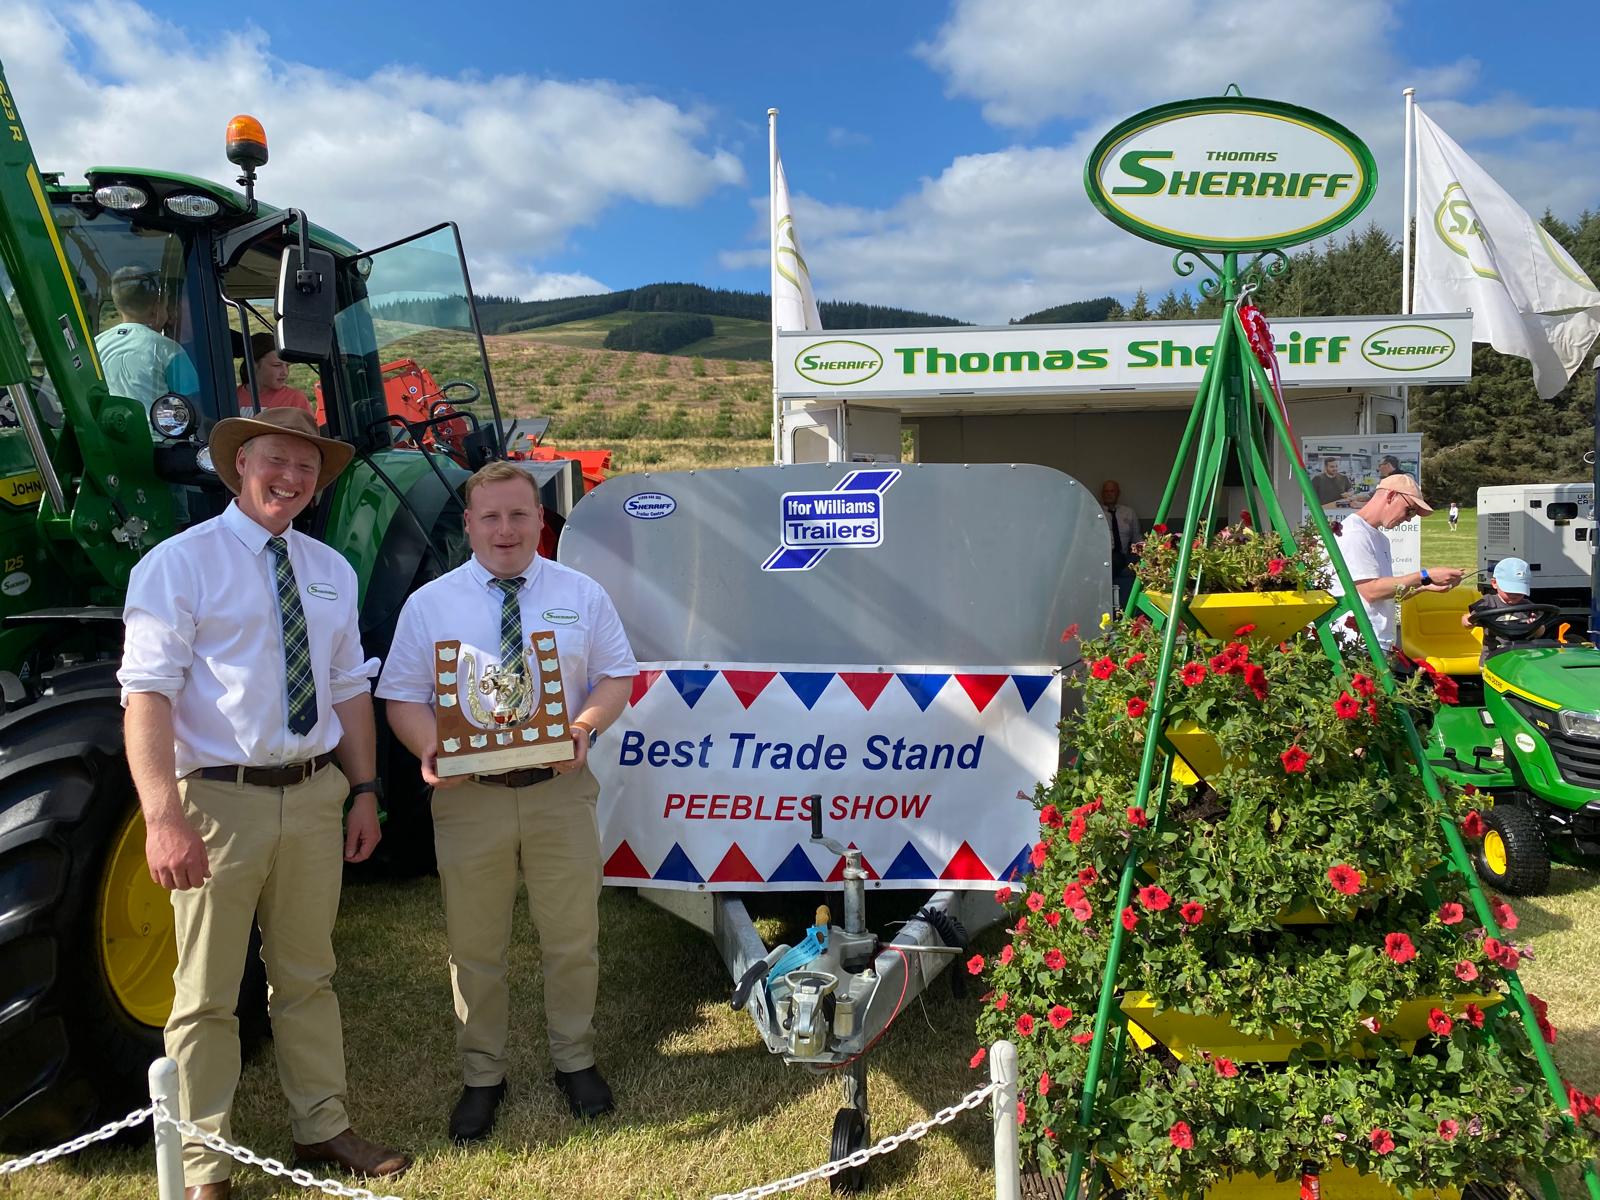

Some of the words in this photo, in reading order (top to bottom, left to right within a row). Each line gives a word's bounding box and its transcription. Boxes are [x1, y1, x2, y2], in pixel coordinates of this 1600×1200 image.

[8, 126, 23, 141] R
[1206, 151, 1279, 162] THOMAS
[1111, 150, 1353, 199] SHERRIFF
[894, 347, 1108, 374] Thomas
[1127, 331, 1350, 368] Sheiff
[1368, 340, 1451, 356] SHERRIFF
[801, 355, 878, 371] SHERRIFF
[11, 480, 42, 497] JOHN
[787, 500, 812, 515] Ifor
[814, 499, 876, 515] Williams
[788, 522, 876, 540] Trailers
[4, 555, 24, 573] 125
[619, 730, 713, 769] Best
[728, 732, 847, 770] Trade
[862, 734, 985, 771] Stand
[663, 793, 815, 821] PEEBLES
[829, 794, 932, 821] SHOW
